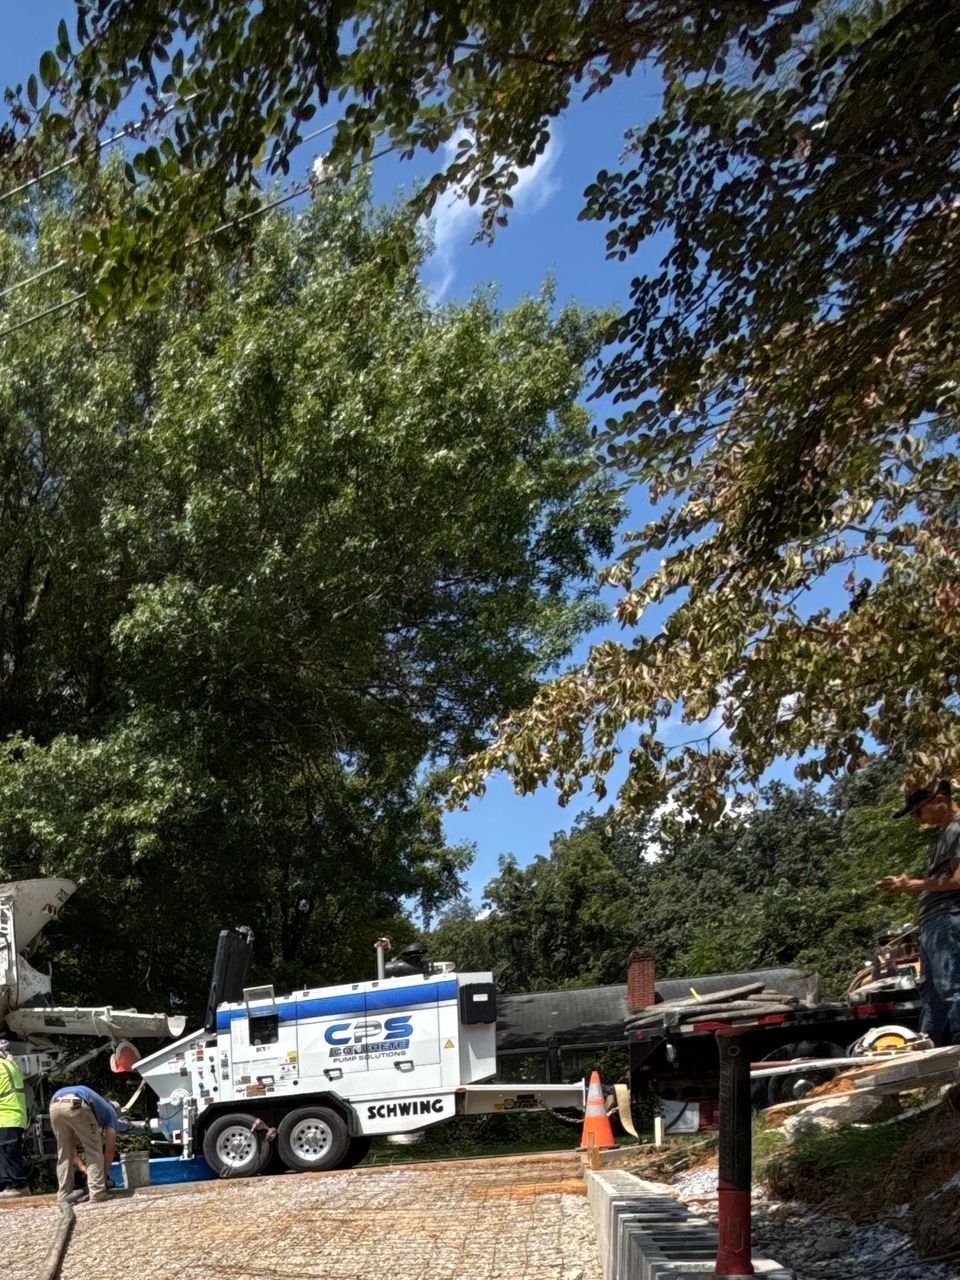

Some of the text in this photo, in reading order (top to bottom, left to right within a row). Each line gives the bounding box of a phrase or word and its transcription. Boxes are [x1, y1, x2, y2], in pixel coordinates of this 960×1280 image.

[324, 1015, 414, 1045] CPS
[333, 1040, 405, 1055] CONCRETE
[333, 1050, 407, 1063] PUMP SOLUTIONS
[368, 1099, 443, 1119] SCHWING
